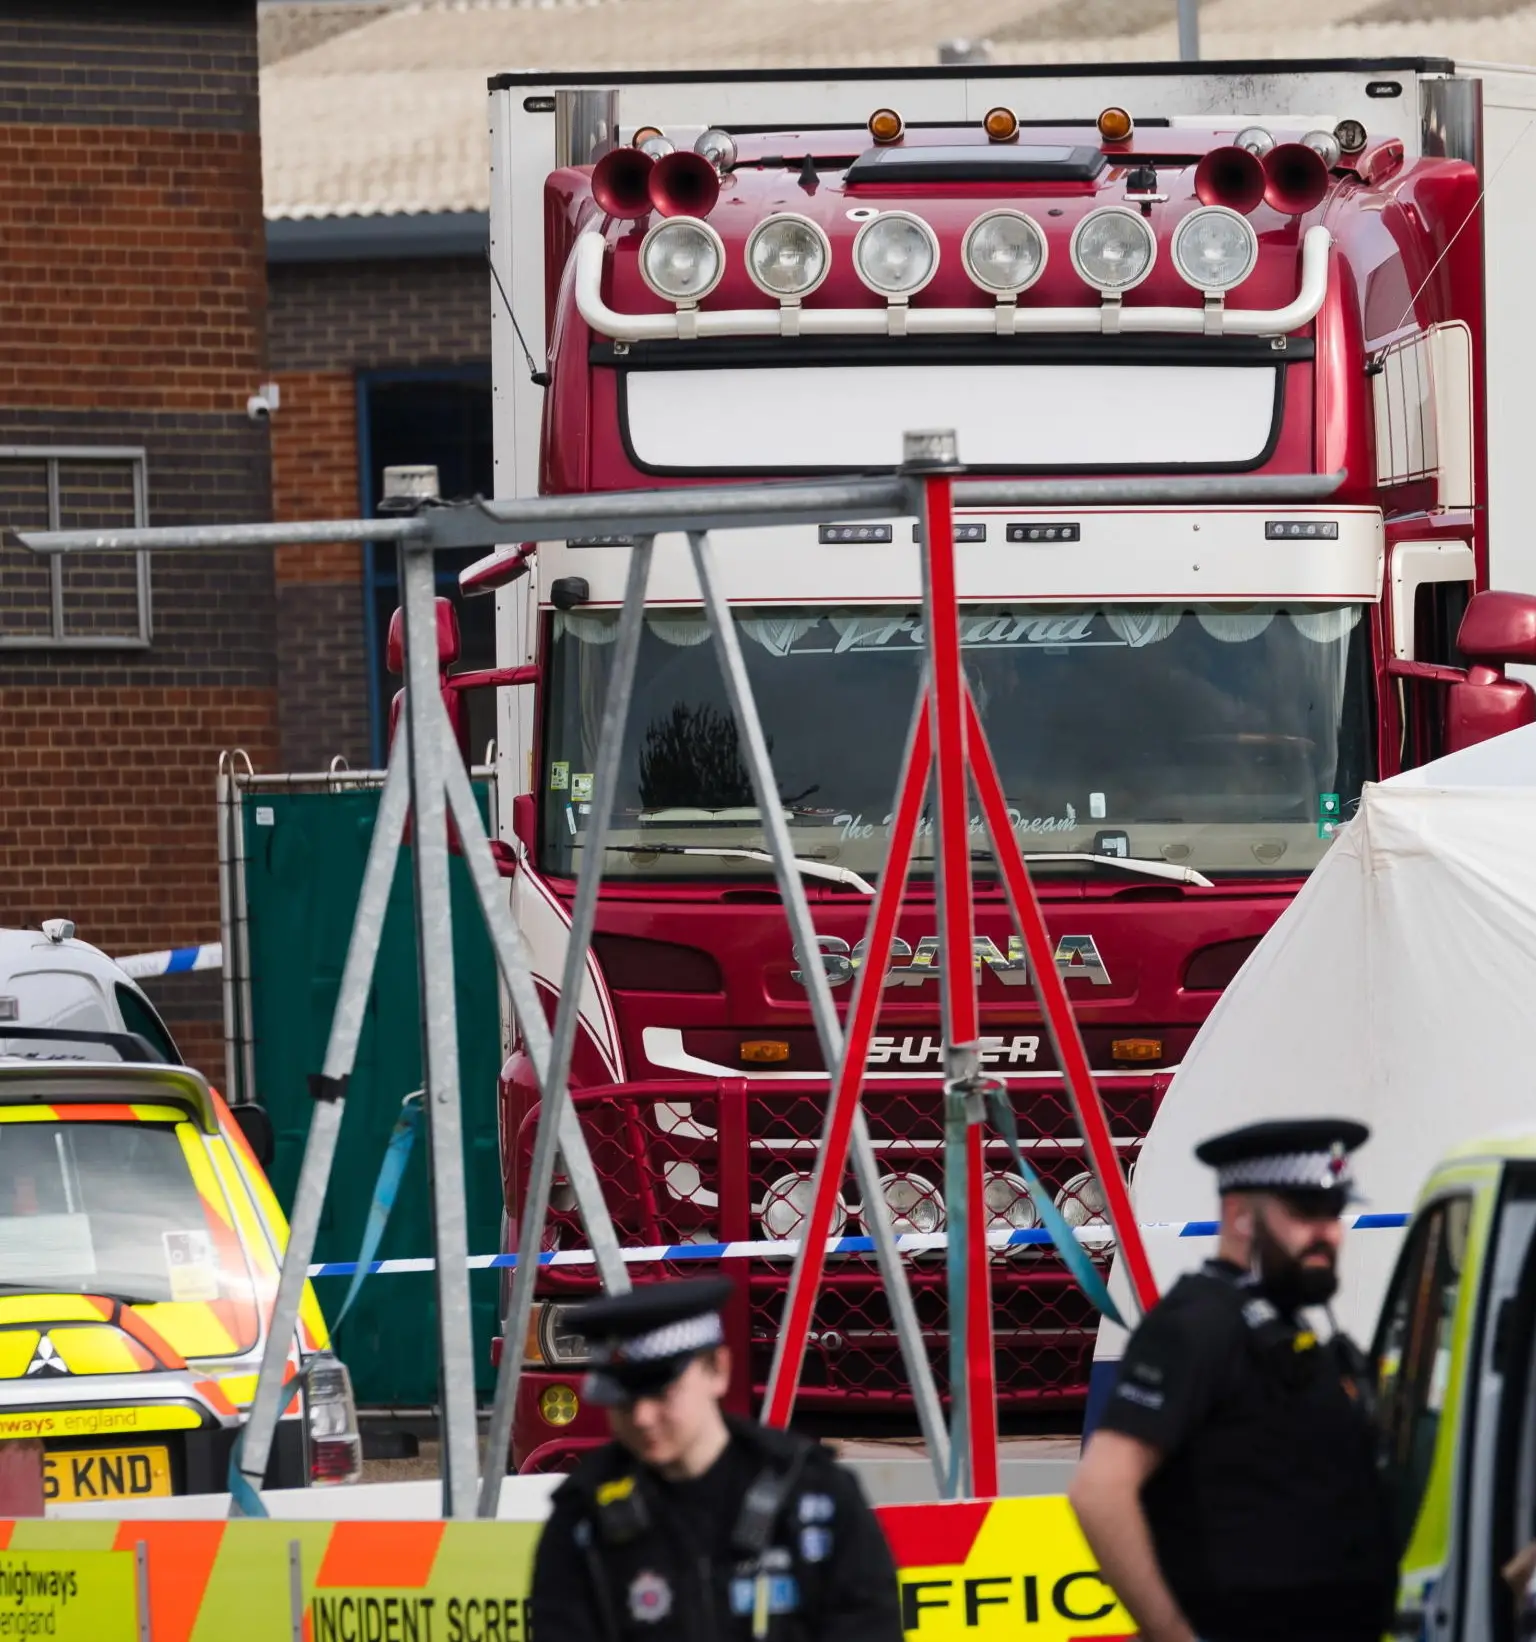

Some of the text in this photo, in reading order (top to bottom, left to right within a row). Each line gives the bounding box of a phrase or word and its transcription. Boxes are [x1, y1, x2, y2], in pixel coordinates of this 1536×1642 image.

[832, 814, 874, 842] The
[1006, 808, 1078, 833] Dream
[790, 935, 1112, 987] SCANA
[867, 1036, 1039, 1063] SUER
[64, 1410, 138, 1432] england
[72, 1454, 152, 1497] KND
[312, 1597, 435, 1642] INCIDENT
